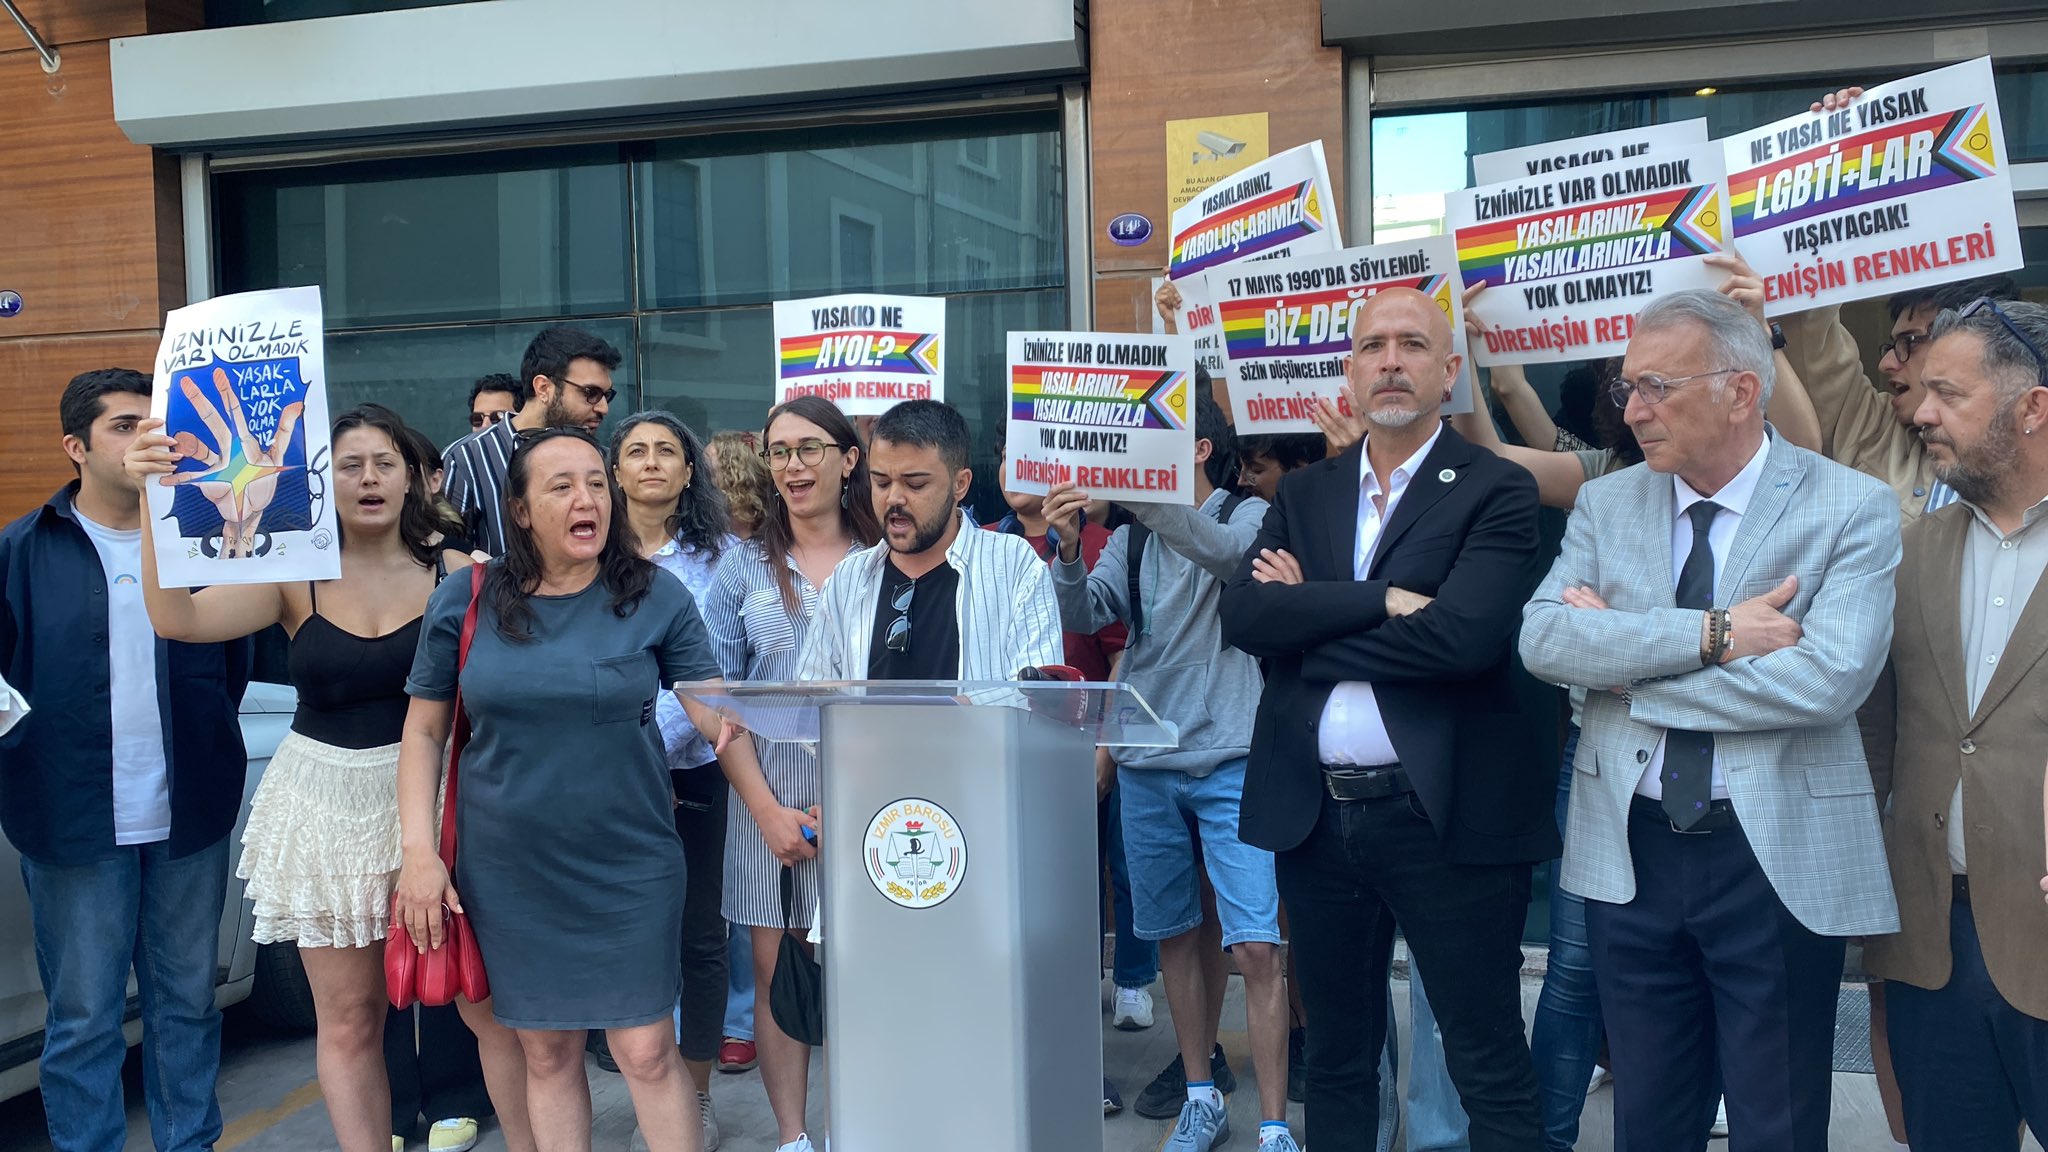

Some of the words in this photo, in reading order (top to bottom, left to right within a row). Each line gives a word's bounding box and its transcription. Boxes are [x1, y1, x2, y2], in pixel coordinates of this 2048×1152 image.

[1751, 136, 1772, 164] NE
[1777, 118, 1822, 153] YASA
[1828, 110, 1850, 139] NE
[1857, 87, 1928, 128] YASAK
[1475, 184, 1554, 221] İZNİNİZLE
[1559, 176, 1596, 204] VAR
[1603, 159, 1692, 197] OLMADIK
[1753, 129, 1936, 220] LGBTİ+LAR
[1202, 172, 1272, 217] YASAKLARINIZ
[1181, 196, 1304, 263] VAROLUŞLARIMIZI
[1516, 202, 1653, 250] YASALARINIZ,
[1783, 203, 1909, 255] YAŞAYACAK!
[1228, 278, 1241, 297] 17
[1245, 274, 1283, 295] MAYIS
[1286, 267, 1346, 289] 1990'DA
[1350, 249, 1431, 282] SÖYLENDİ:
[1504, 231, 1672, 283] YASAKLARINIZLA
[1763, 257, 1846, 301] ENİŞİN
[1853, 222, 1996, 283] RENKLERİ
[1524, 285, 1559, 310] YOK
[1564, 269, 1652, 305] OLMAYIZ!
[812, 305, 875, 331] YASA(K)
[881, 306, 902, 328] NE
[1264, 300, 1301, 347] BİZ
[1309, 288, 1377, 345] DEĞ
[1484, 315, 1588, 354] DİRENİŞİN
[164, 349, 206, 374] VAR
[228, 339, 309, 361] OLMADIK
[815, 334, 896, 369] AYOL?
[1024, 338, 1064, 363] İZNİNİZLE
[1067, 342, 1092, 364] VAR
[1096, 343, 1167, 367] OLMADIK
[232, 363, 291, 386] YASAK-
[1040, 371, 1134, 401] YASALARINIZ,
[1240, 360, 1267, 382] SİZİN
[1270, 357, 1345, 384] DÜŞÜNCELERİ
[240, 381, 296, 401] LARLA
[247, 398, 282, 417] YOK
[856, 380, 931, 401] RENKLERİ
[1247, 391, 1320, 423] DİRENİŞ
[1033, 398, 1147, 427] YASAKLARINIZLA
[255, 429, 276, 446] YIZ
[1040, 427, 1055, 449] YOK
[1059, 430, 1127, 453] OLMAYIZ!
[1077, 464, 1177, 491] RENKLERİ
[903, 804, 955, 840] BAROSU
